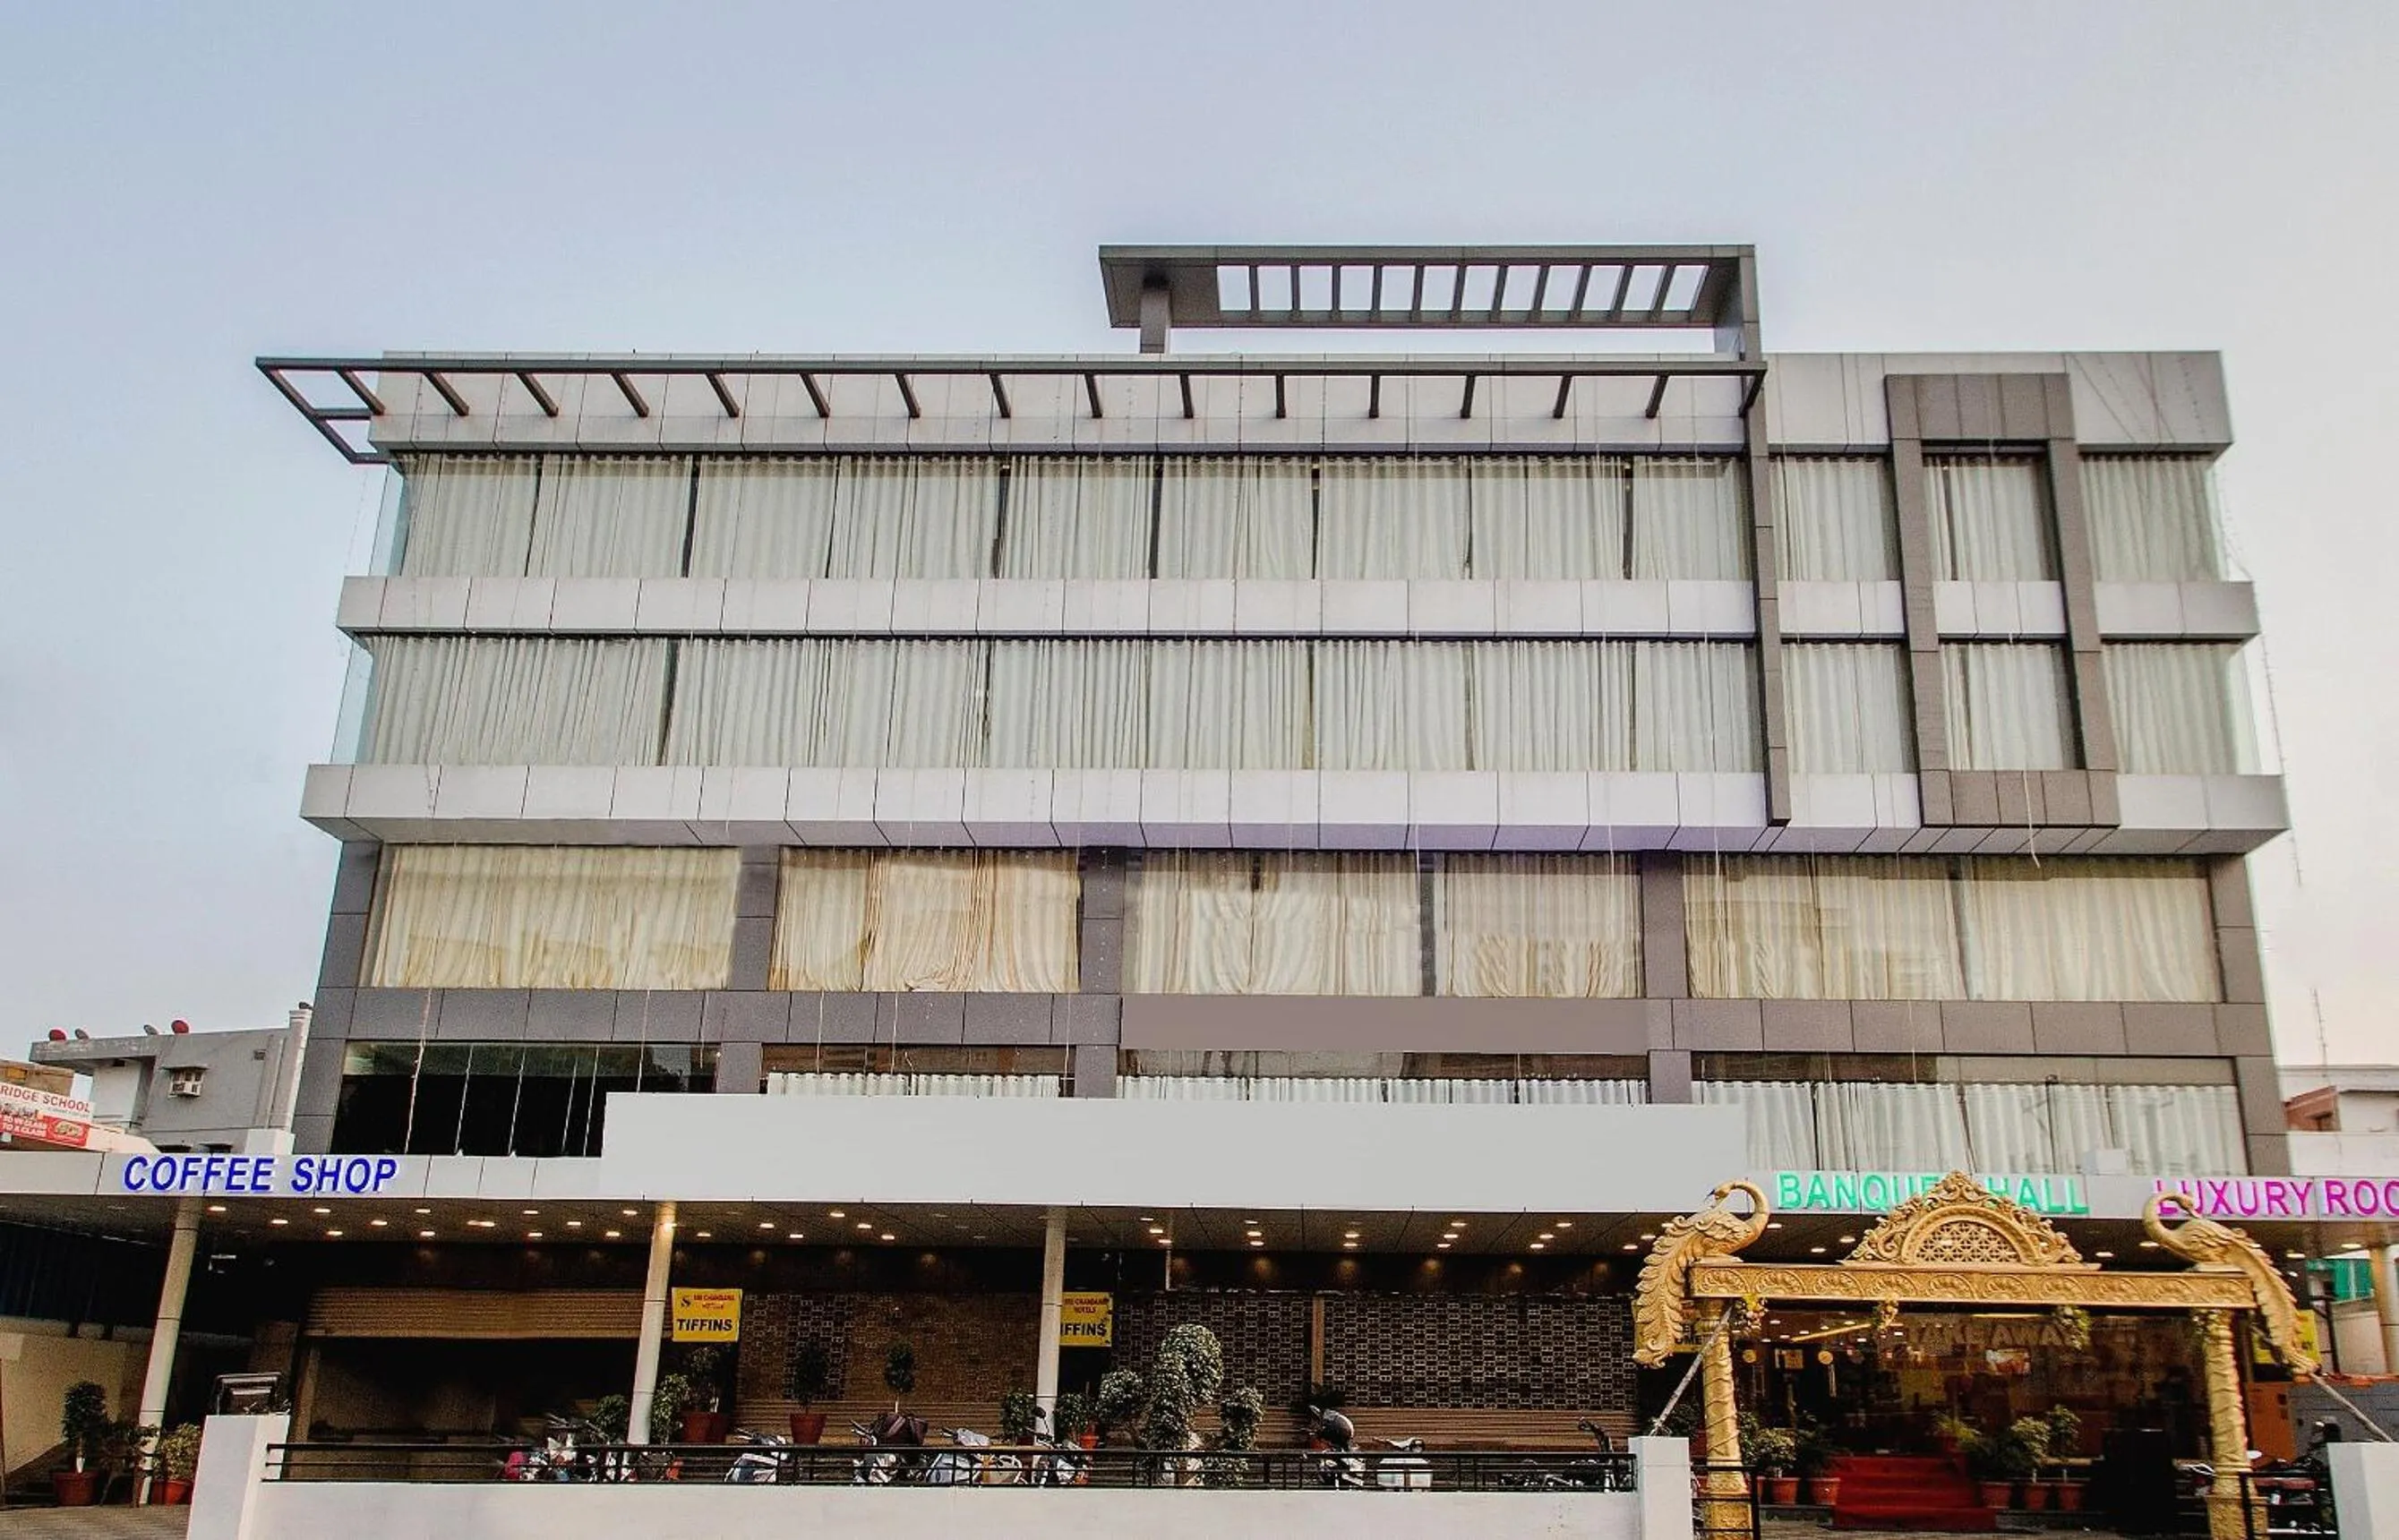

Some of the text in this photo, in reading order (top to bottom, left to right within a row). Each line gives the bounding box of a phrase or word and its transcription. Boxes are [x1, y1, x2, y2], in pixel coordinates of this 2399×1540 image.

[42, 1094, 90, 1113] SCHOOL
[123, 1155, 398, 1193] COFFEE SHOP
[1777, 1173, 1943, 1211] BANQUE
[2154, 1179, 2313, 1217] LUXURY
[676, 1318, 733, 1331] TIFFINS
[1060, 1322, 1107, 1337] IFFINS
